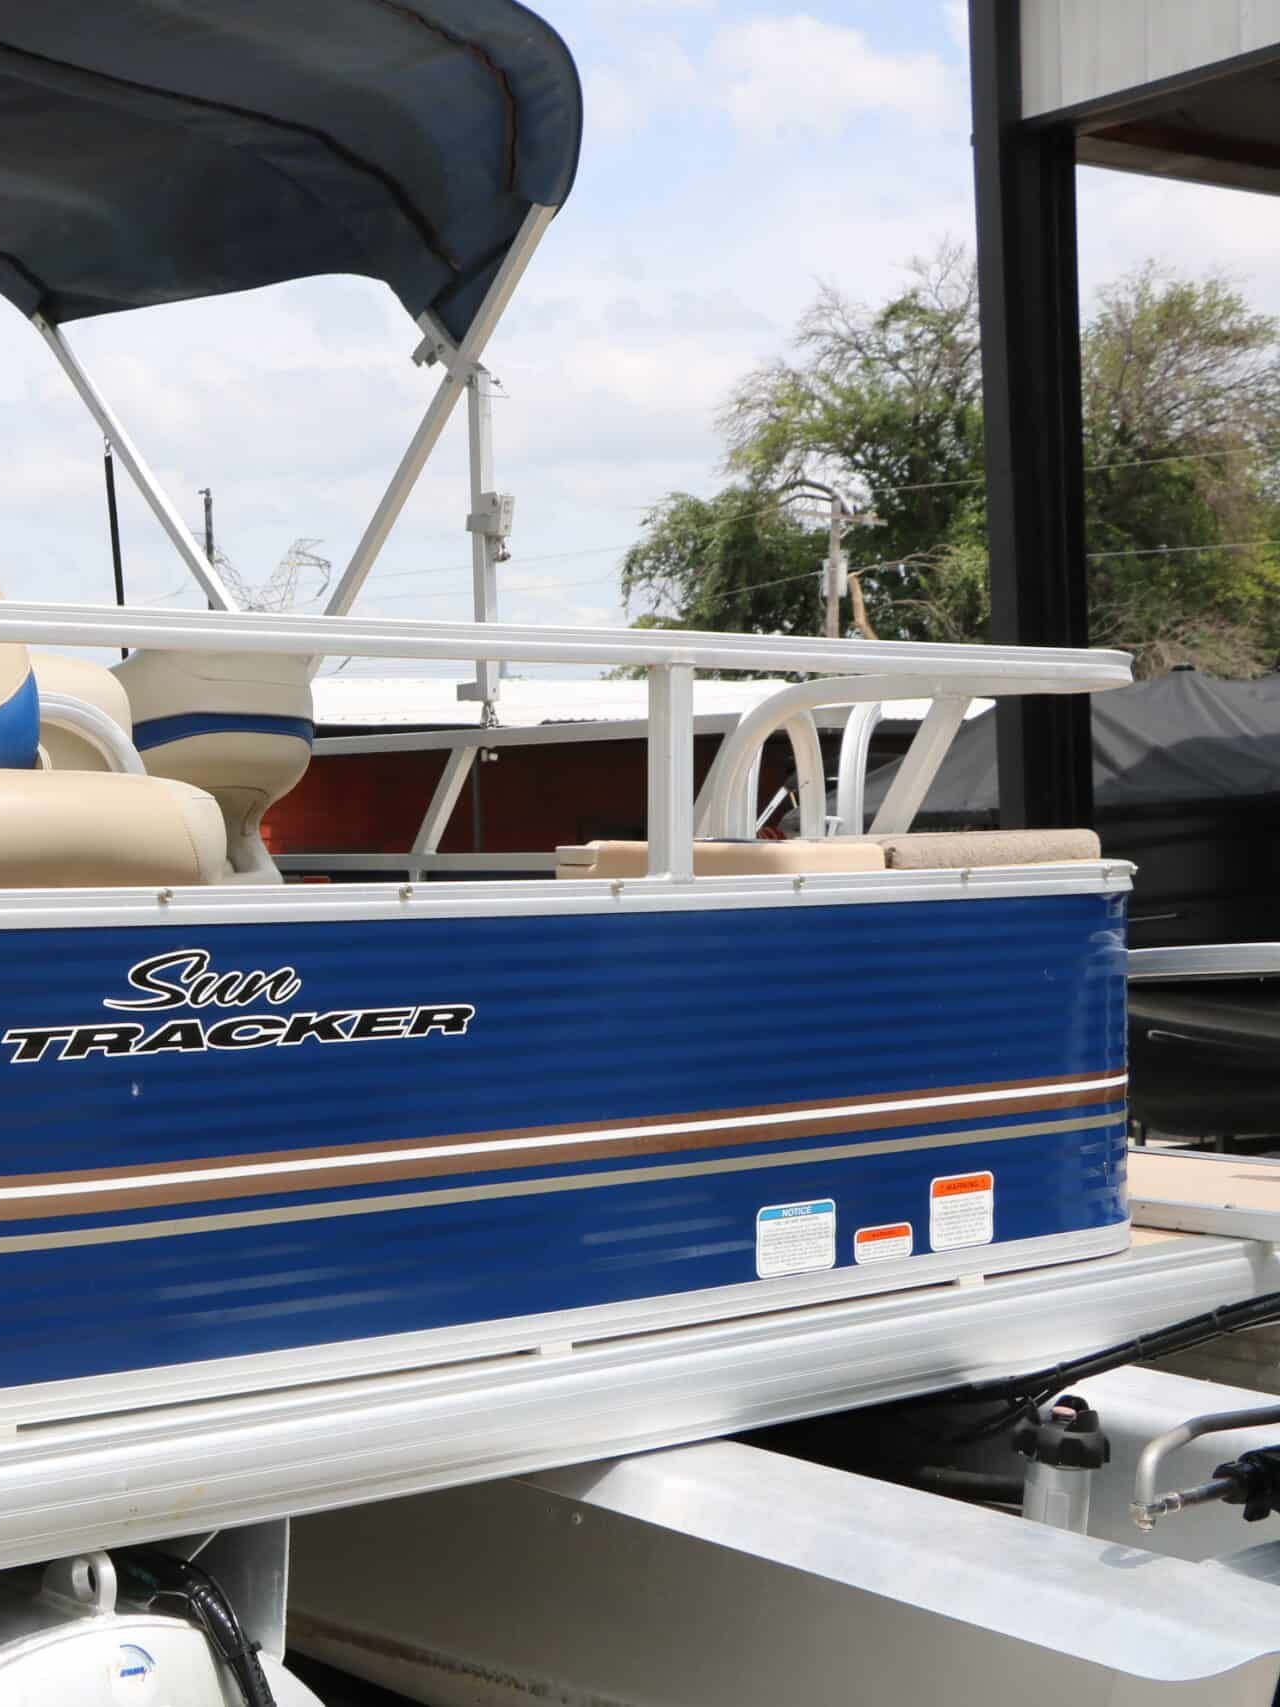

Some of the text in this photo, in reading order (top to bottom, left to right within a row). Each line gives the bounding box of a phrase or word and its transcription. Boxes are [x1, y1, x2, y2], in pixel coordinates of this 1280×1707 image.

[103, 949, 301, 1011] Sun
[1, 1004, 475, 1063] TRACKER
[782, 1205, 813, 1217] NOTICE
